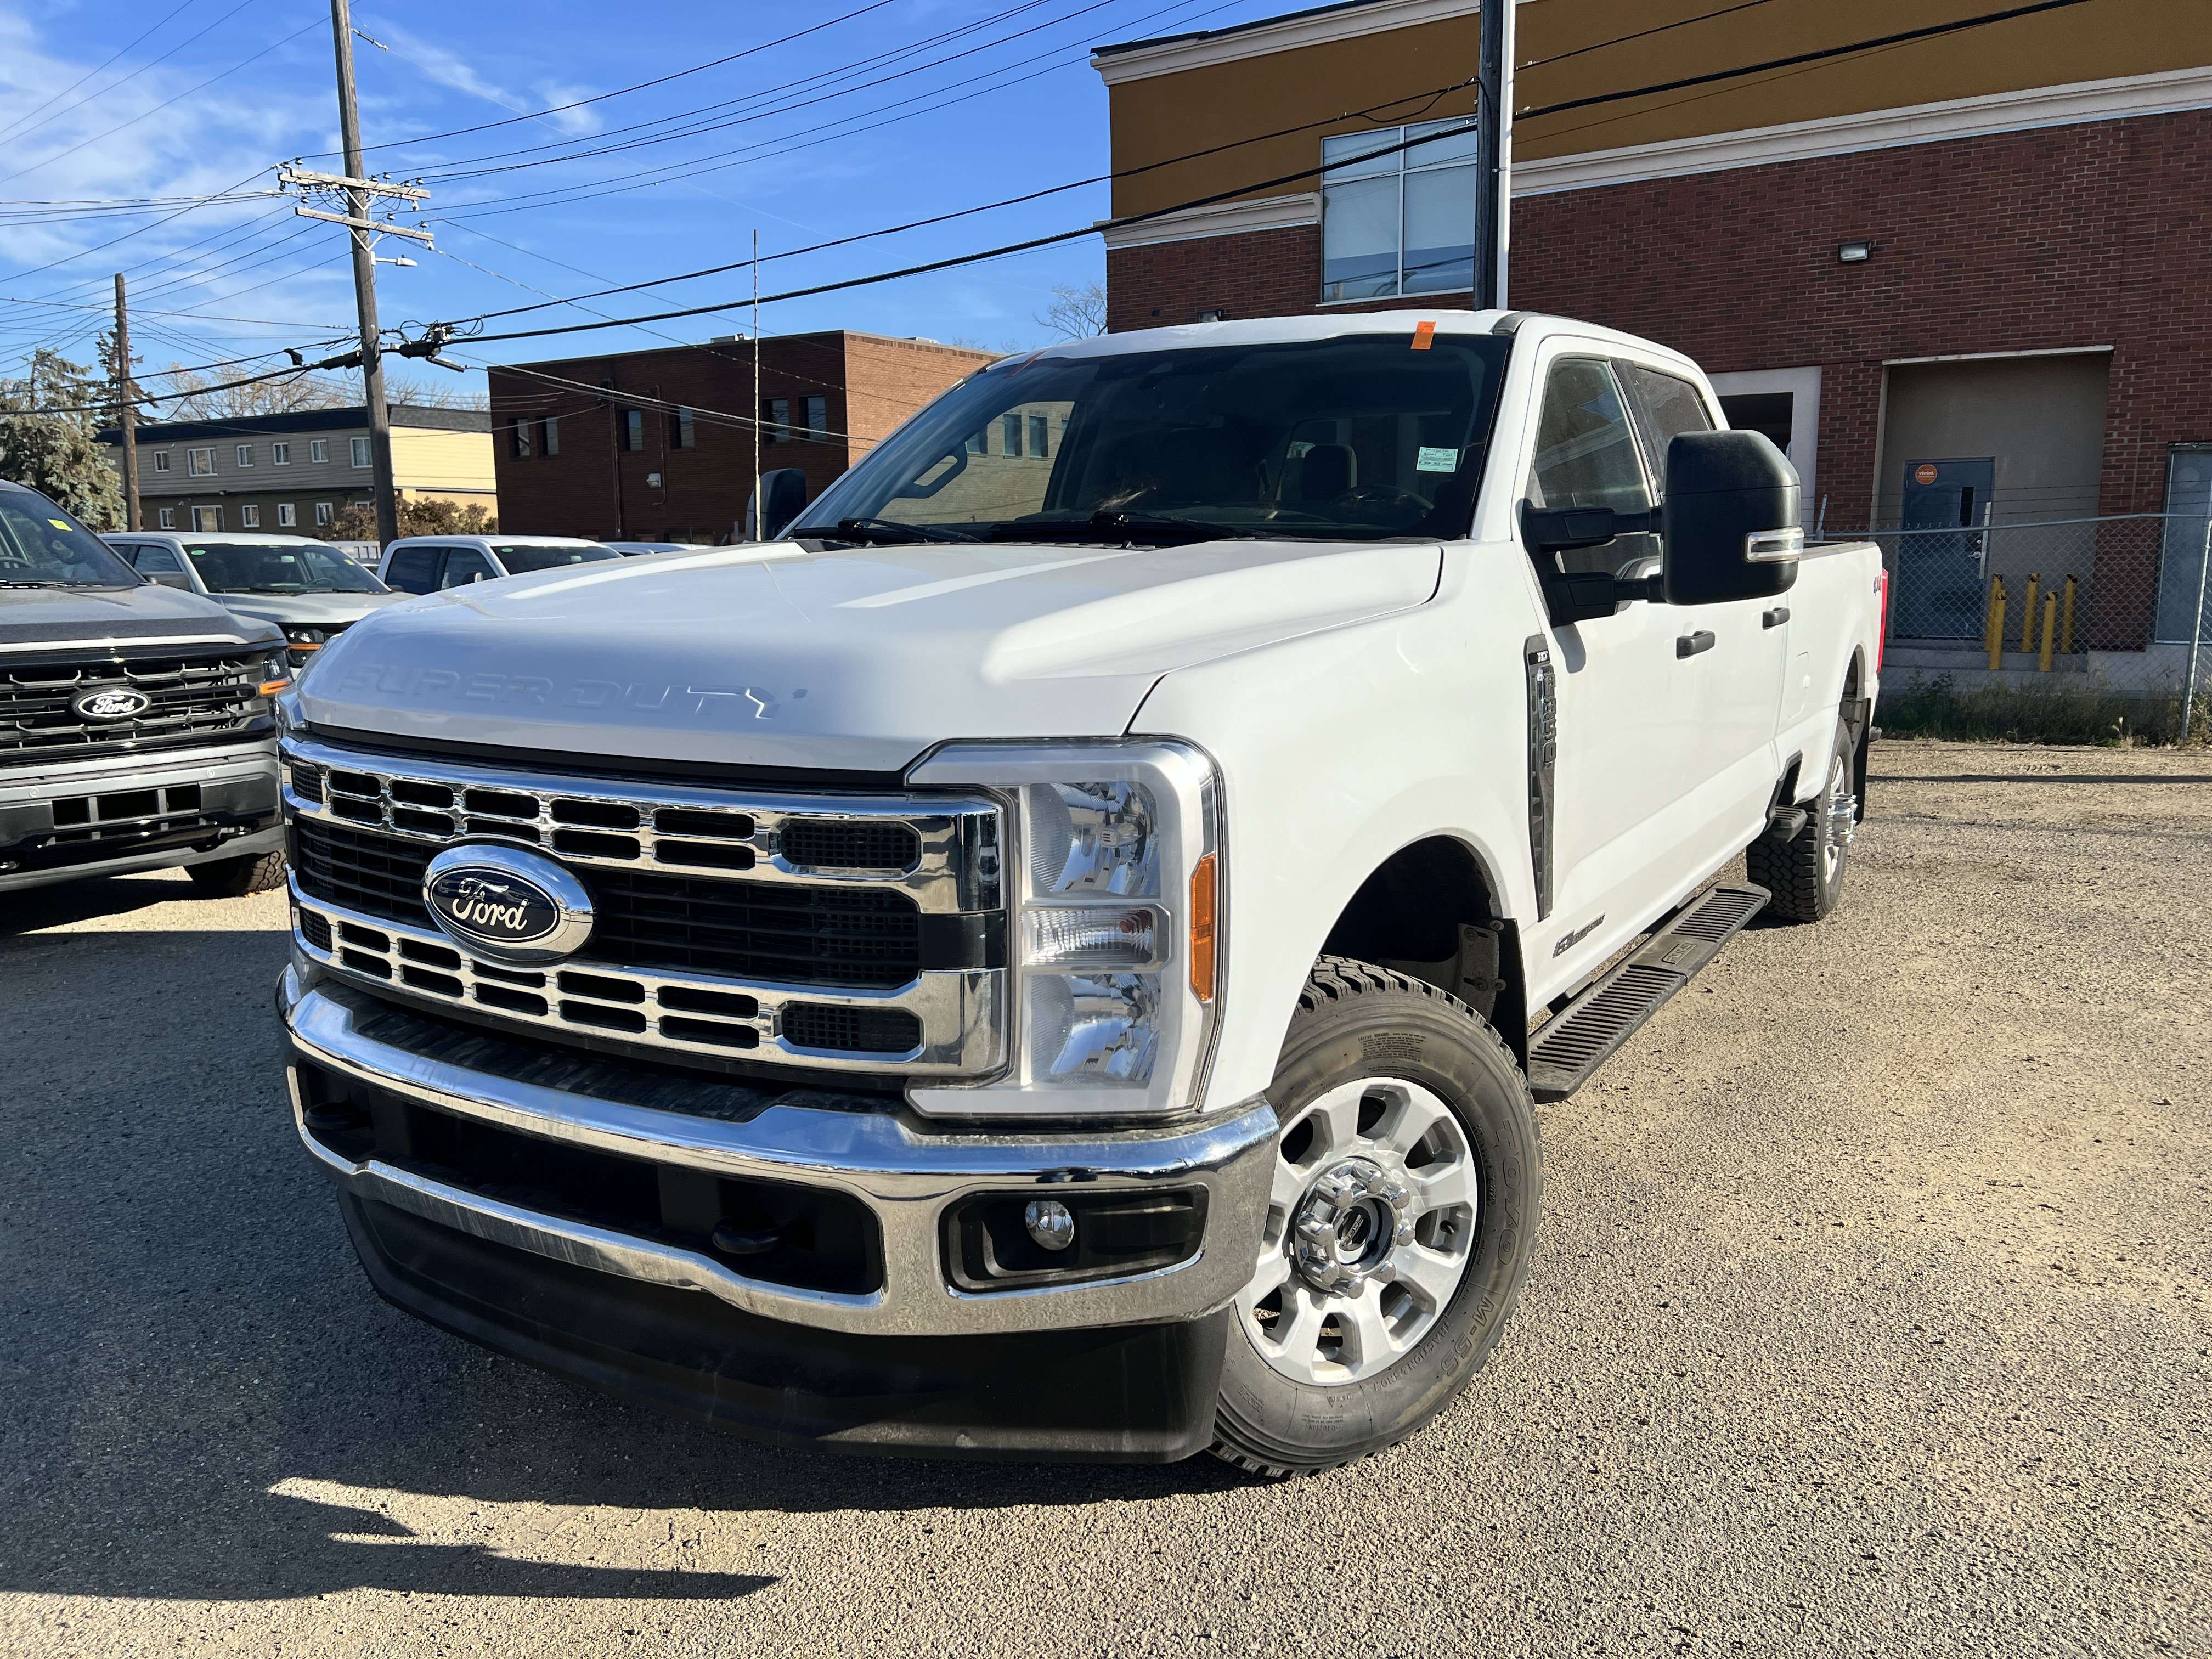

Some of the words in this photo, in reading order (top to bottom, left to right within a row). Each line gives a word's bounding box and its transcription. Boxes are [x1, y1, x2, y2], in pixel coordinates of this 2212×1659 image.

[92, 695, 135, 714] Ford
[337, 663, 554, 706] SUPER
[562, 679, 808, 720] DUTY
[452, 877, 529, 931] Ford
[1495, 1119, 1521, 1266] TOYO
